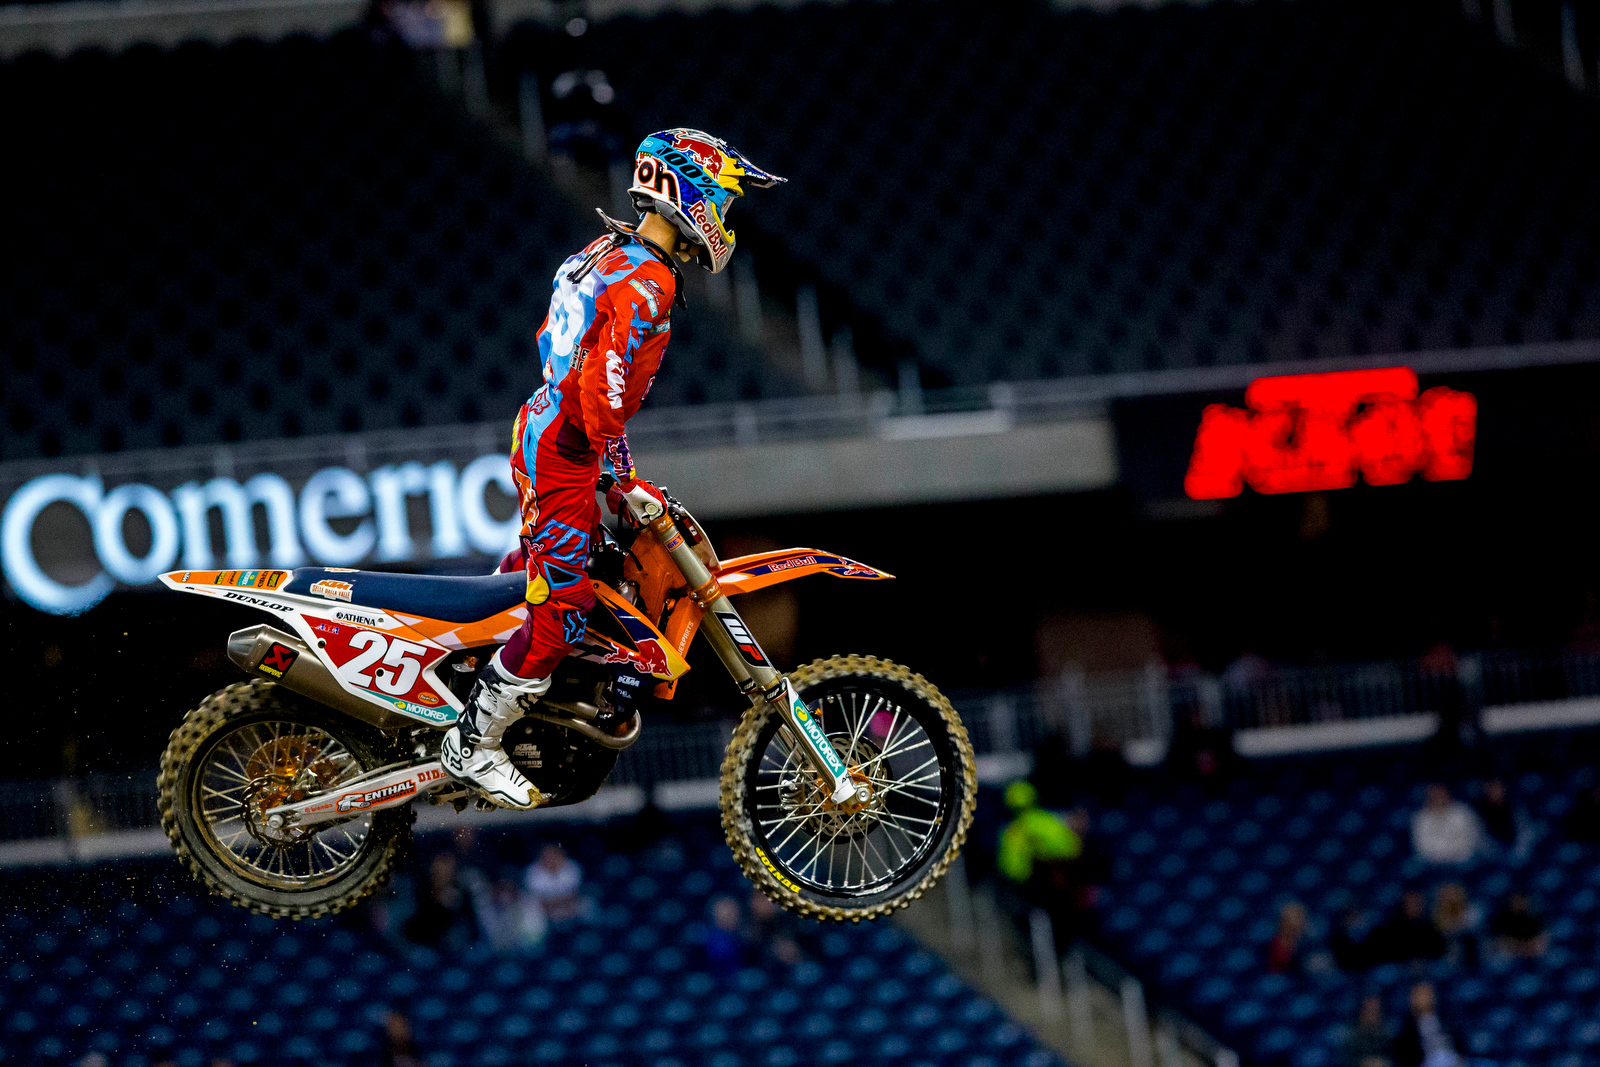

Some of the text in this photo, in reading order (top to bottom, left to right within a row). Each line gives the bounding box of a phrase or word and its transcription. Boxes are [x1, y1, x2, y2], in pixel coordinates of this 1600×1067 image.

[655, 145, 722, 197] 100%
[688, 200, 728, 260] Red Bull
[768, 556, 818, 573] Red Bull
[318, 580, 351, 591] KTM
[223, 591, 294, 613] DUNLOP
[342, 613, 376, 627] ATHENA
[678, 620, 695, 656] ERPARTS
[337, 630, 428, 696] 25
[617, 675, 641, 688] KTM
[405, 703, 449, 721] MOTOREX
[803, 719, 842, 773] MOTOREX
[310, 803, 334, 813] brembo
[755, 847, 802, 894] DUNLOP
